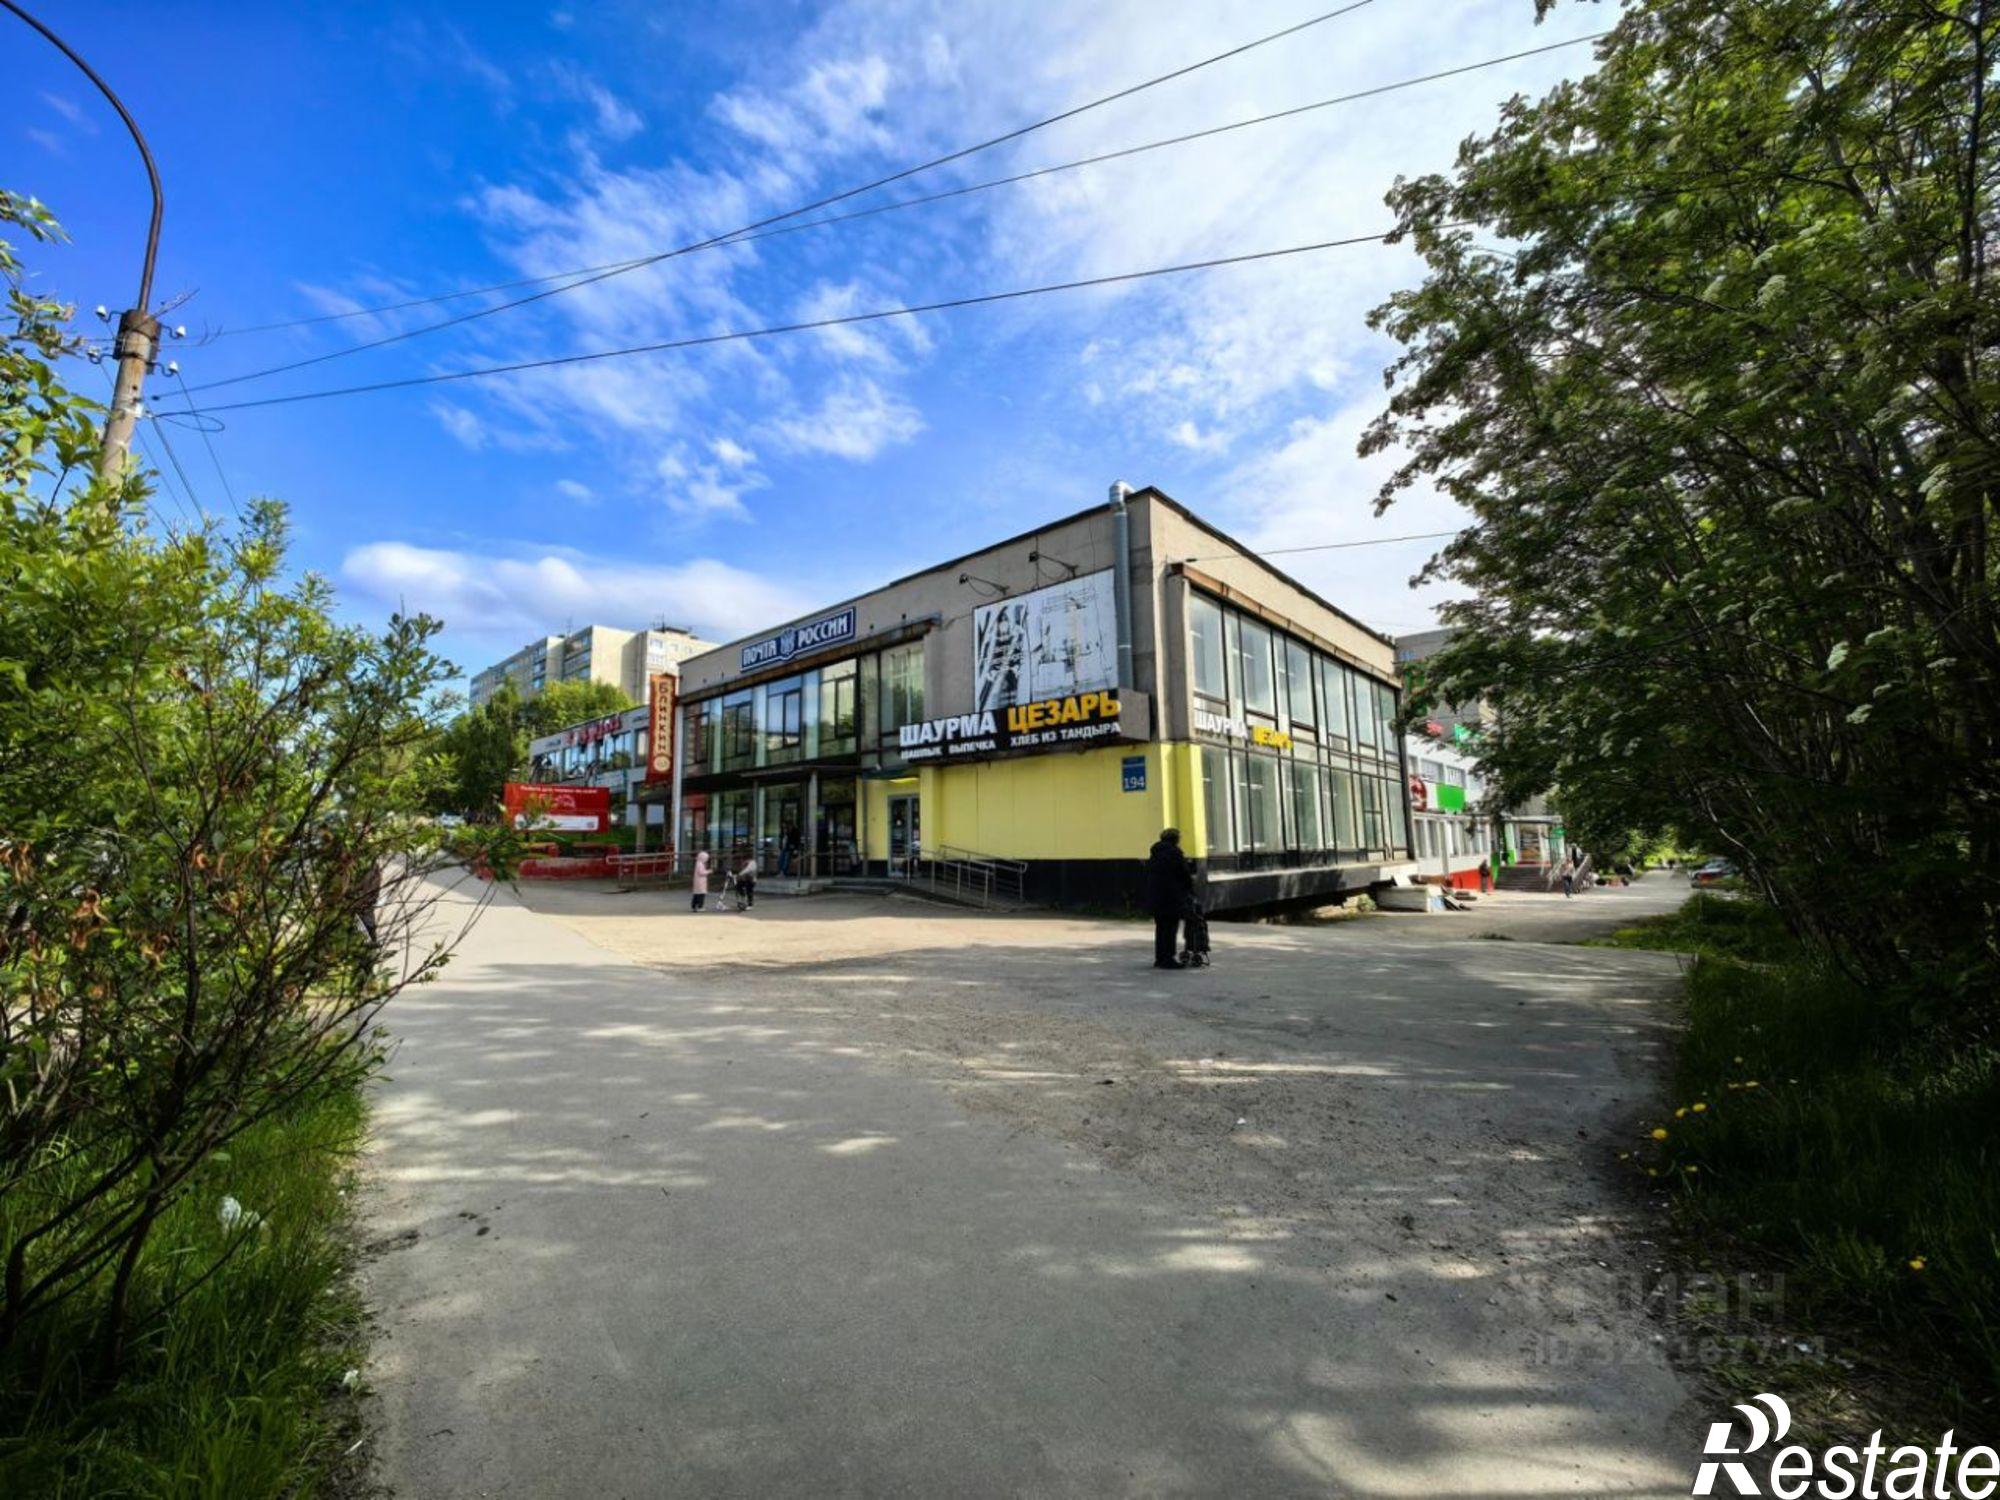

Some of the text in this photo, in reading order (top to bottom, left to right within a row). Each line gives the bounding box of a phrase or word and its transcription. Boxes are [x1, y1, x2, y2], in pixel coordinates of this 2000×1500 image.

[743, 615, 848, 668] ПОЧТА РОССИИ
[899, 691, 1122, 748] ШАУРМА ЦЕЗАРЬ
[1194, 709, 1248, 739] ШАУРМА
[948, 740, 996, 755] ВЫПЕЧКА
[1009, 732, 1039, 747] ХЛЕБ
[1041, 730, 1057, 743] ИЗ
[1060, 721, 1122, 740] ТАНДЫРА
[1124, 776, 1145, 789] 194
